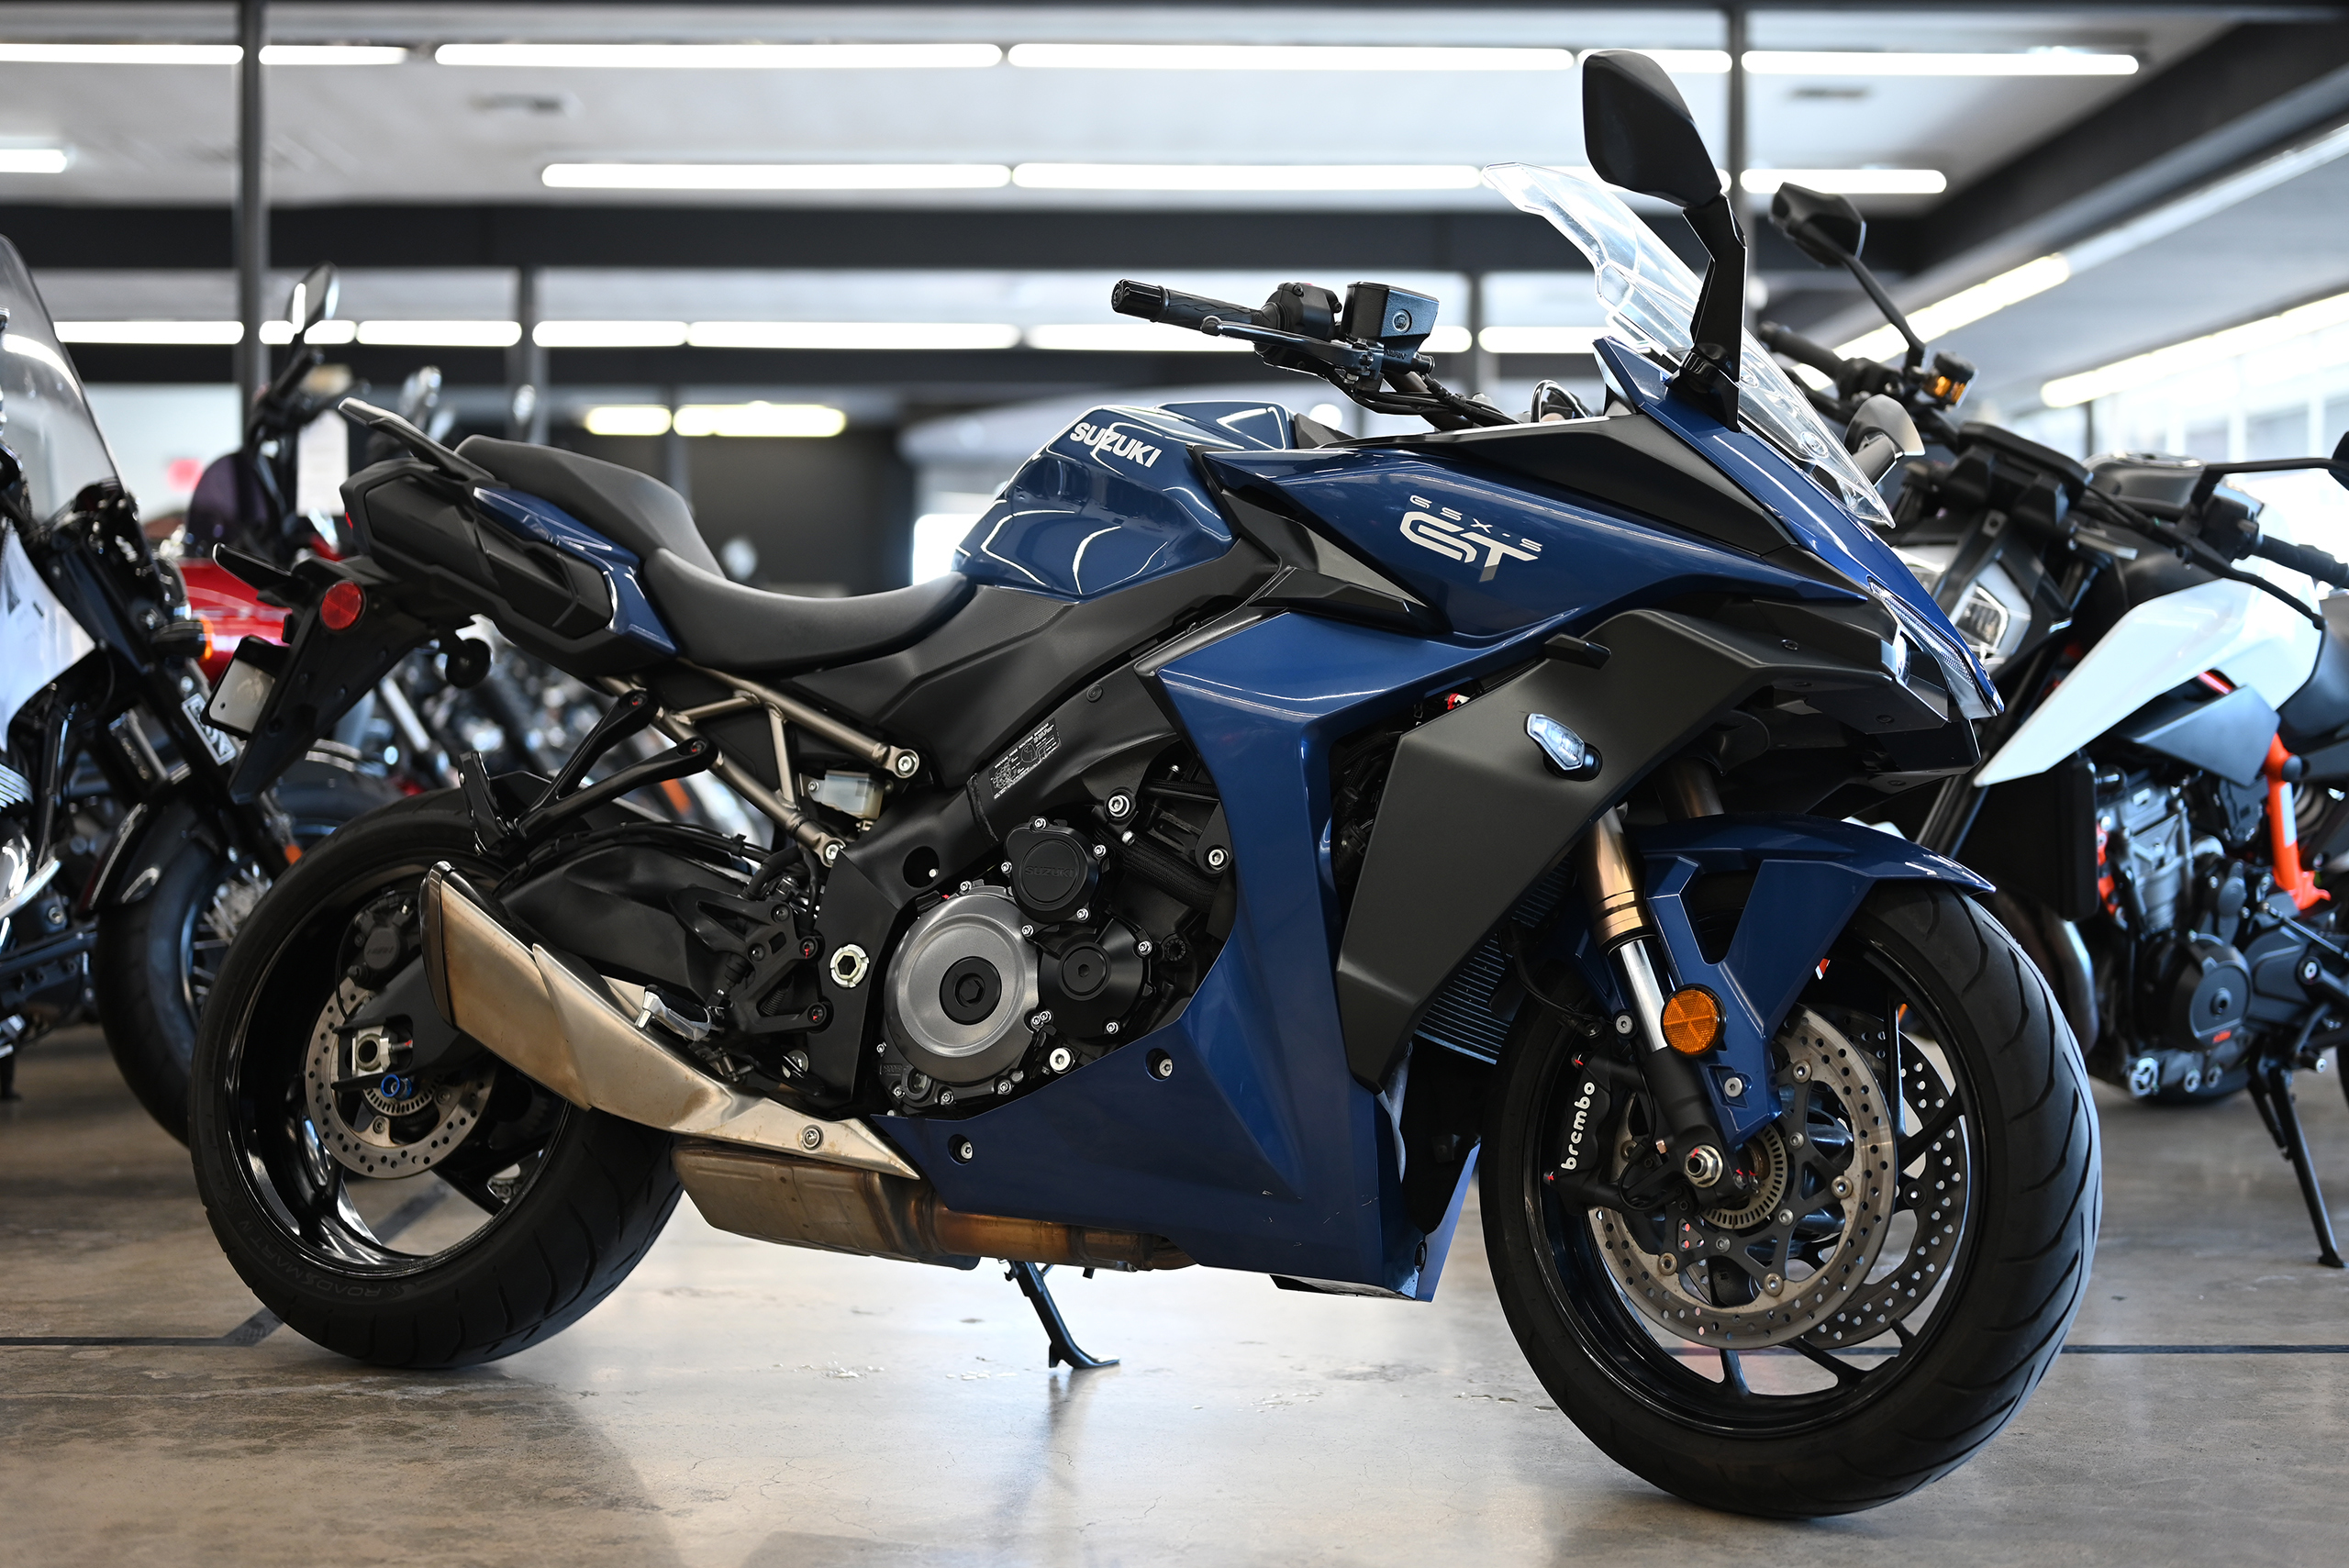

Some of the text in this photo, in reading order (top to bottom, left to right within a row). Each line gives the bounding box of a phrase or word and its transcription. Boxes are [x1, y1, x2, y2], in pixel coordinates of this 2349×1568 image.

[1069, 422, 1163, 468] SUZUKI
[1399, 511, 1539, 583] GT
[1409, 495, 1543, 552] GSX-S
[1025, 865, 1074, 878] SUZUKI
[1560, 1082, 1596, 1171] brembo
[250, 1235, 382, 1297] ROADSMART
